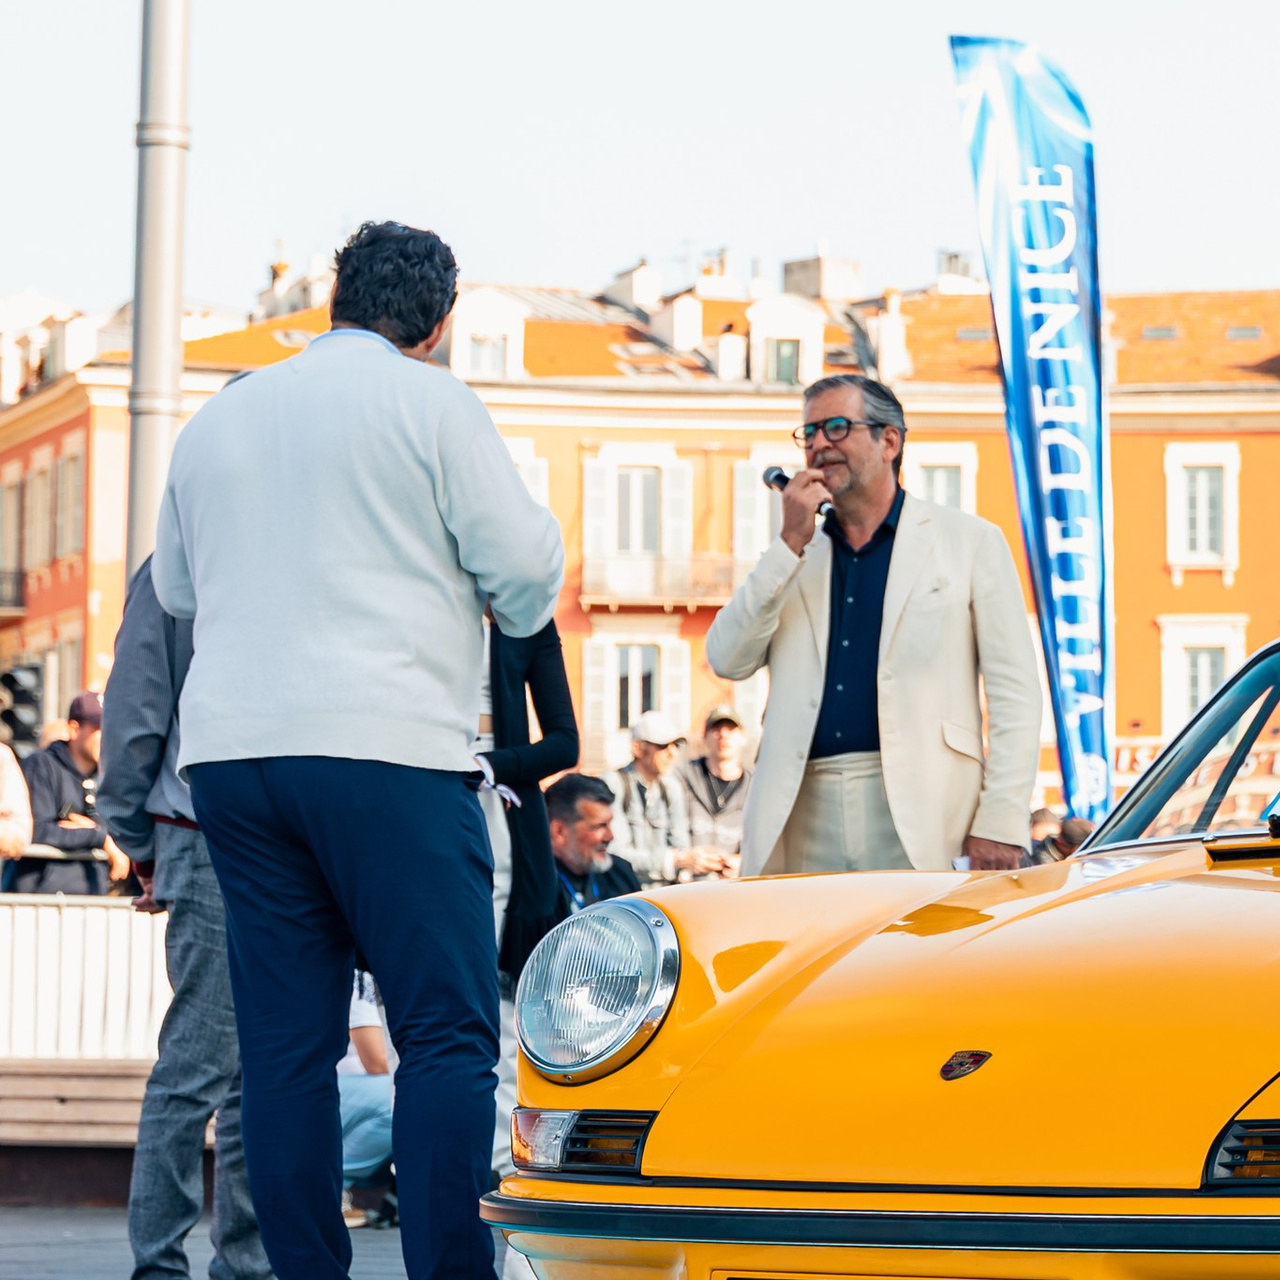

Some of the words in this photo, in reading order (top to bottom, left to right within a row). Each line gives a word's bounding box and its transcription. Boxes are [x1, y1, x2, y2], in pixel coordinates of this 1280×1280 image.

[1011, 164, 1083, 362] NICE
[1032, 384, 1091, 494] DE
[1045, 516, 1104, 728] VILLE
